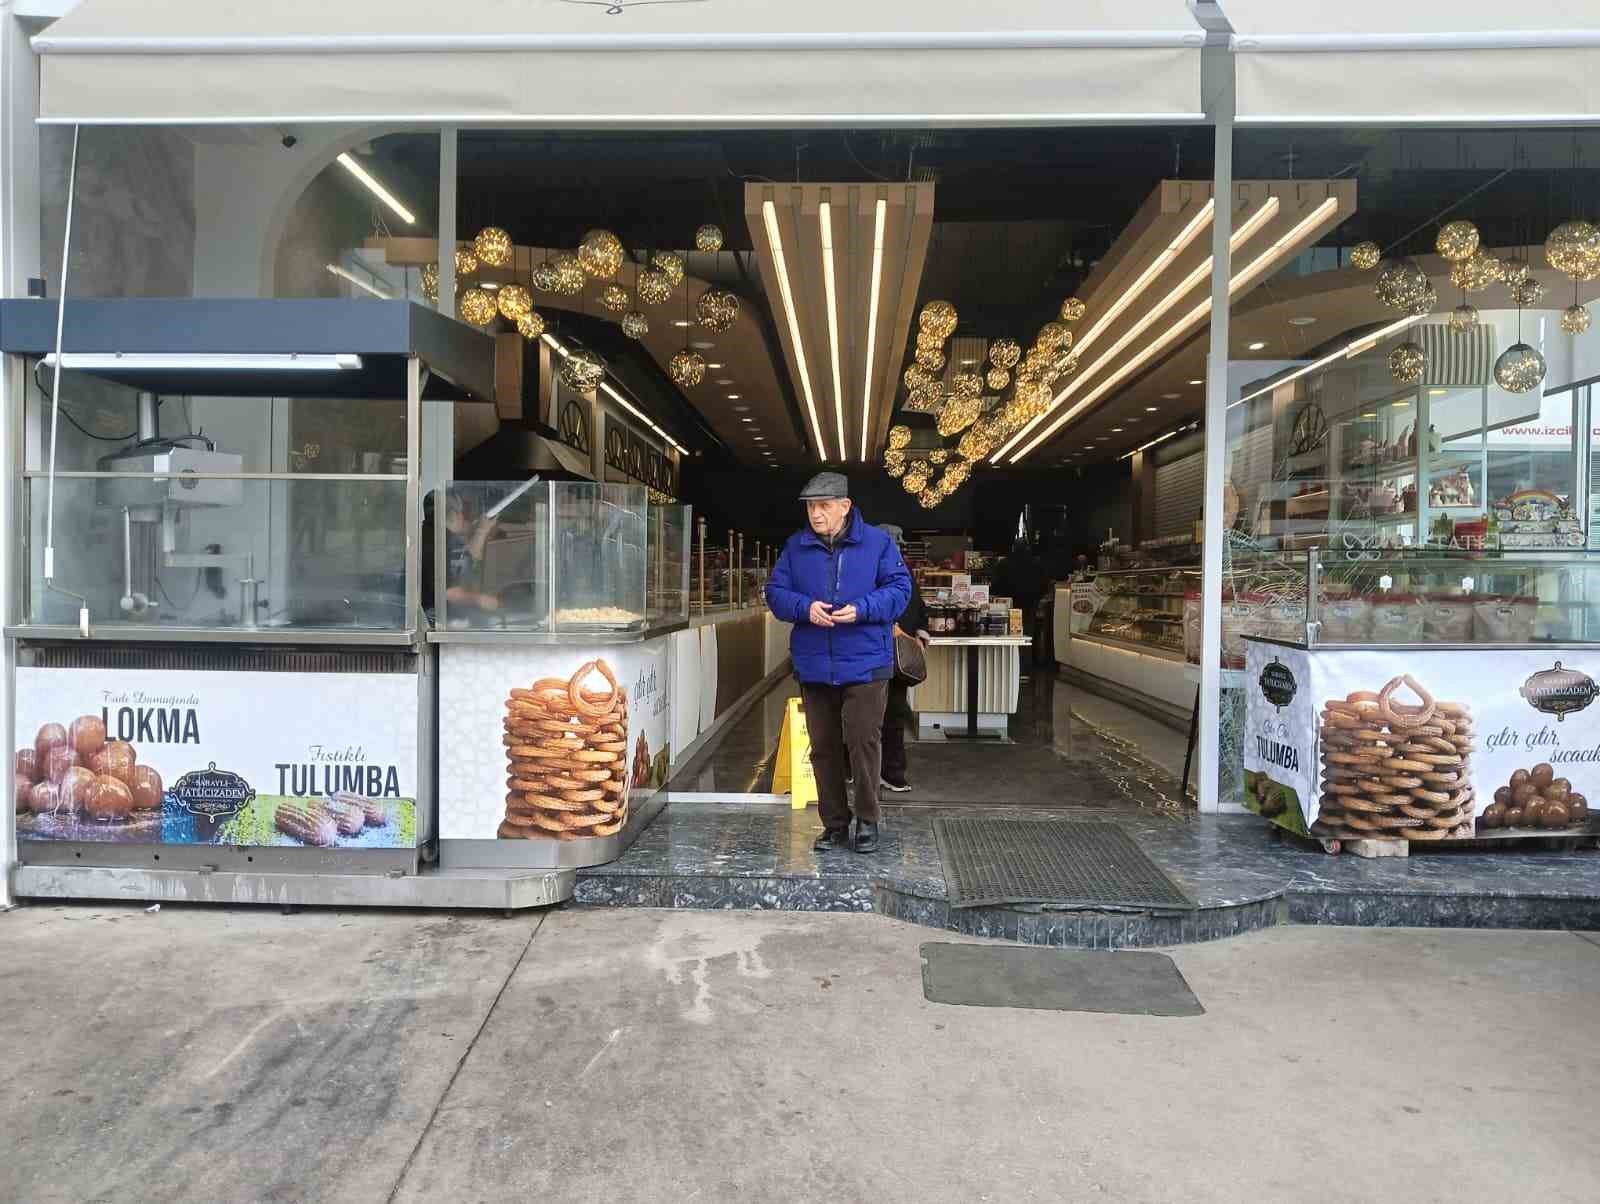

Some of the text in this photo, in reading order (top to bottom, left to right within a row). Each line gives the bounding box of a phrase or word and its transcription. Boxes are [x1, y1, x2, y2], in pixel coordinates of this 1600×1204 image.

[102, 706, 200, 744] LOKMA
[1256, 735, 1299, 773] TULUMBA
[275, 764, 400, 797] TULUMBA
